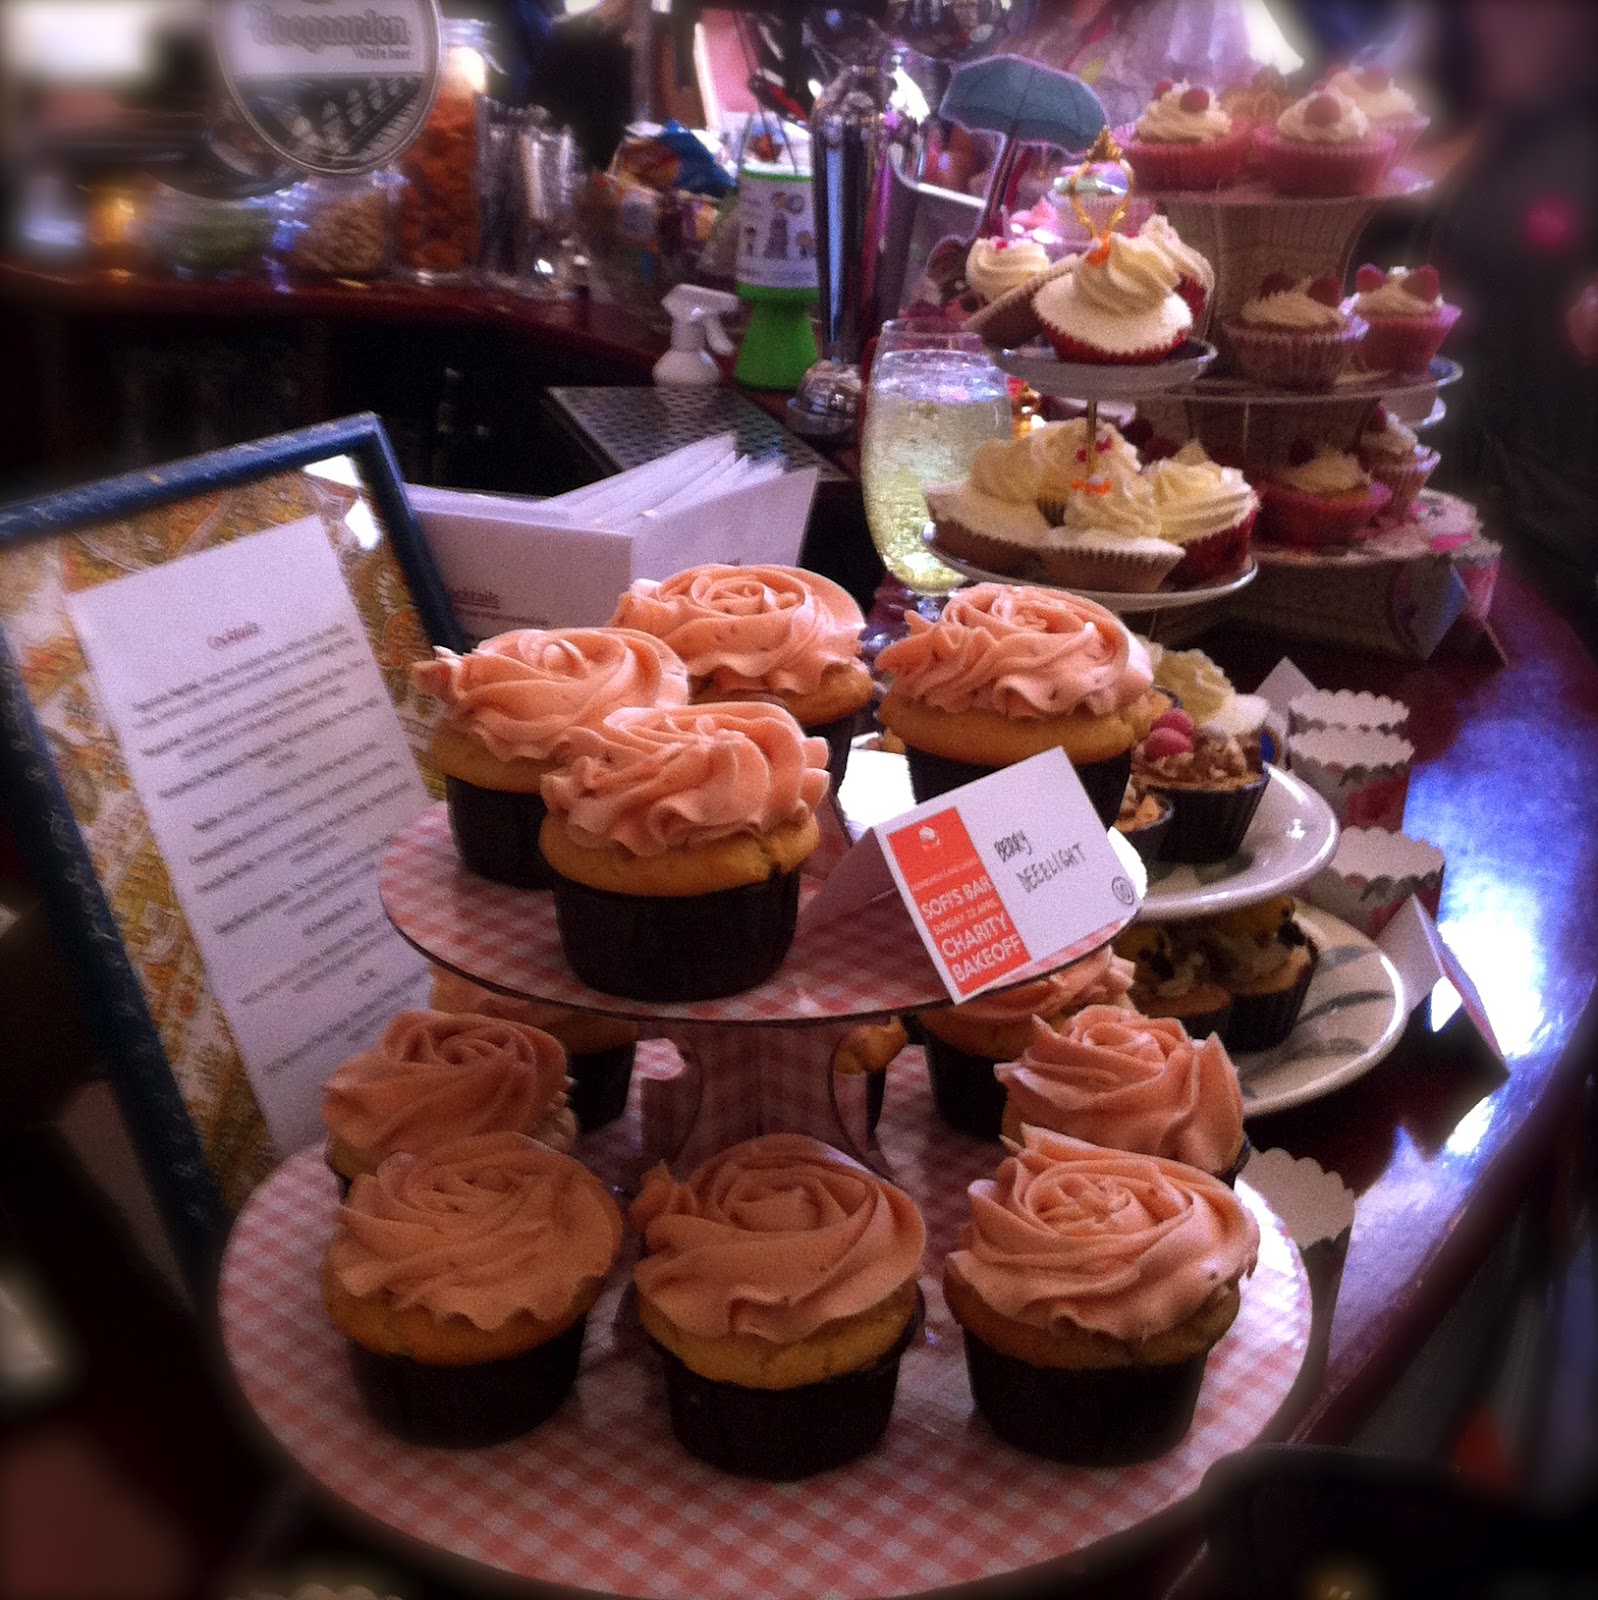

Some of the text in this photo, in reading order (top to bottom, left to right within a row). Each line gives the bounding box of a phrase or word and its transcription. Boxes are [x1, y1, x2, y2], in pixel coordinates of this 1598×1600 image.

[993, 829, 1032, 863] BERRY
[962, 875, 996, 901] BAR
[941, 912, 1009, 959] CHARITY
[952, 933, 1021, 983] BAKEOFF
